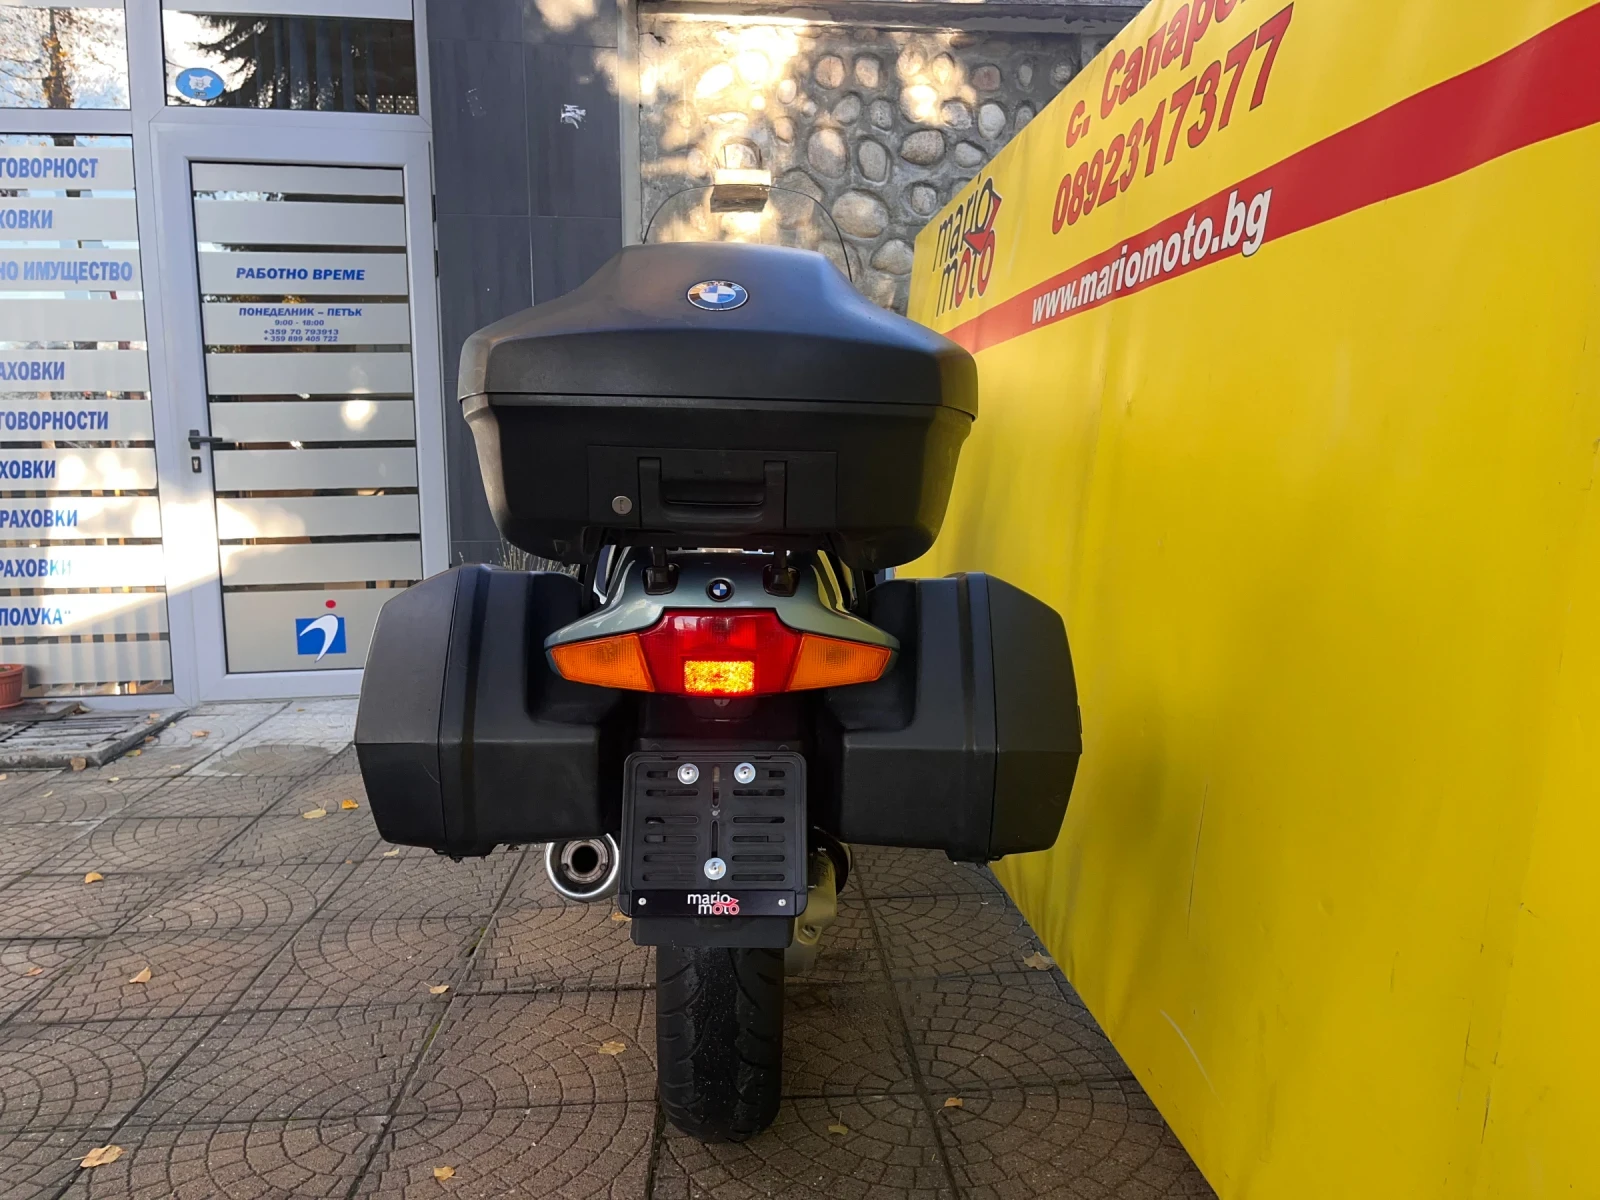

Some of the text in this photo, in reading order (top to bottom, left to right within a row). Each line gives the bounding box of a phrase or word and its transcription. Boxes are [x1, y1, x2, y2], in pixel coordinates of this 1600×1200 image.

[1101, 0, 1246, 119] Сапар
[1051, 2, 1294, 235] 0892317377
[932, 172, 994, 272] mario
[1031, 187, 1273, 325] www.mariomoto.bg
[24, 261, 133, 284] ИМУЩЕСТВО
[236, 267, 366, 281] РАБОТНО ВРЕМЕ
[935, 230, 996, 318] moto
[238, 307, 315, 317] ПОНЕДЕЛНИК
[327, 308, 363, 317] ПЕТЪК
[0, 509, 78, 528] РАХОВКИ
[687, 891, 731, 905] mario
[698, 903, 740, 915] moto
